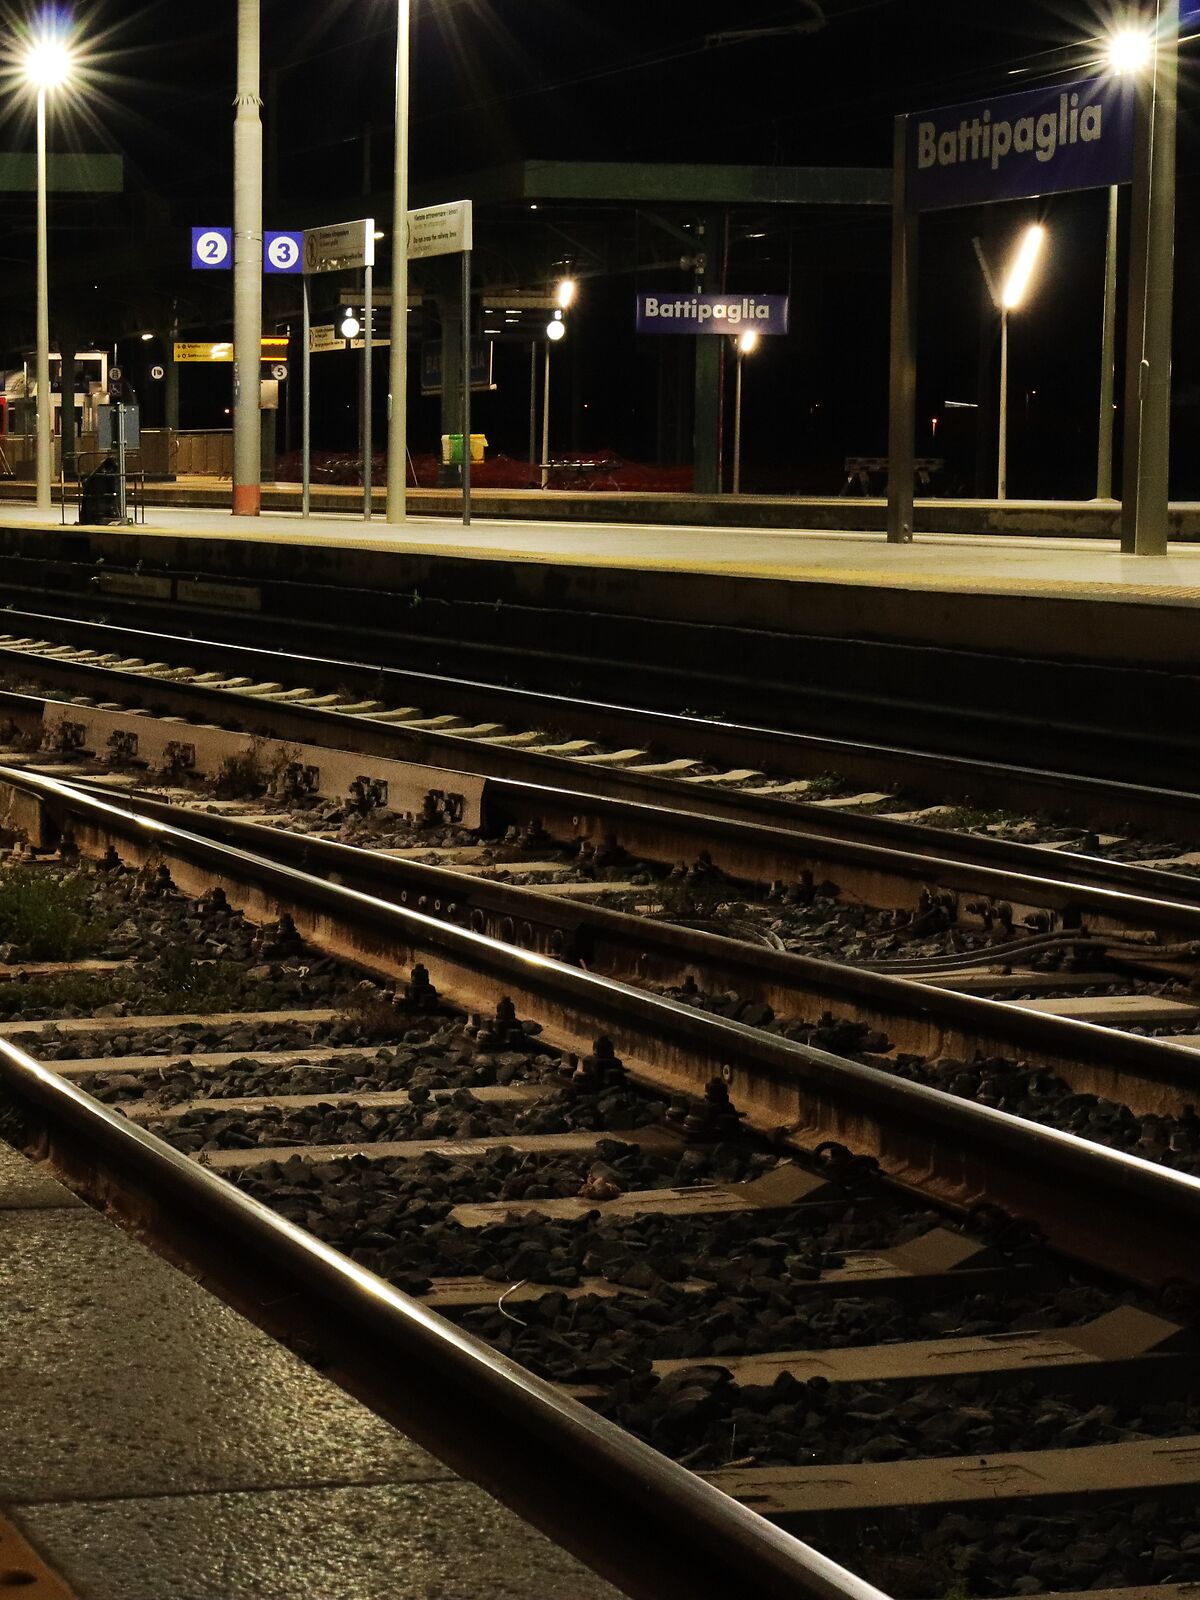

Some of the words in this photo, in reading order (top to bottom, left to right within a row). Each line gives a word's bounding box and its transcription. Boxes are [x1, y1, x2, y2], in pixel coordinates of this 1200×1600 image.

[917, 92, 1102, 170] Battipaglia
[205, 240, 219, 258] 2
[276, 243, 291, 262] 3
[645, 298, 769, 324] Battipaglia
[277, 367, 284, 377] 5
